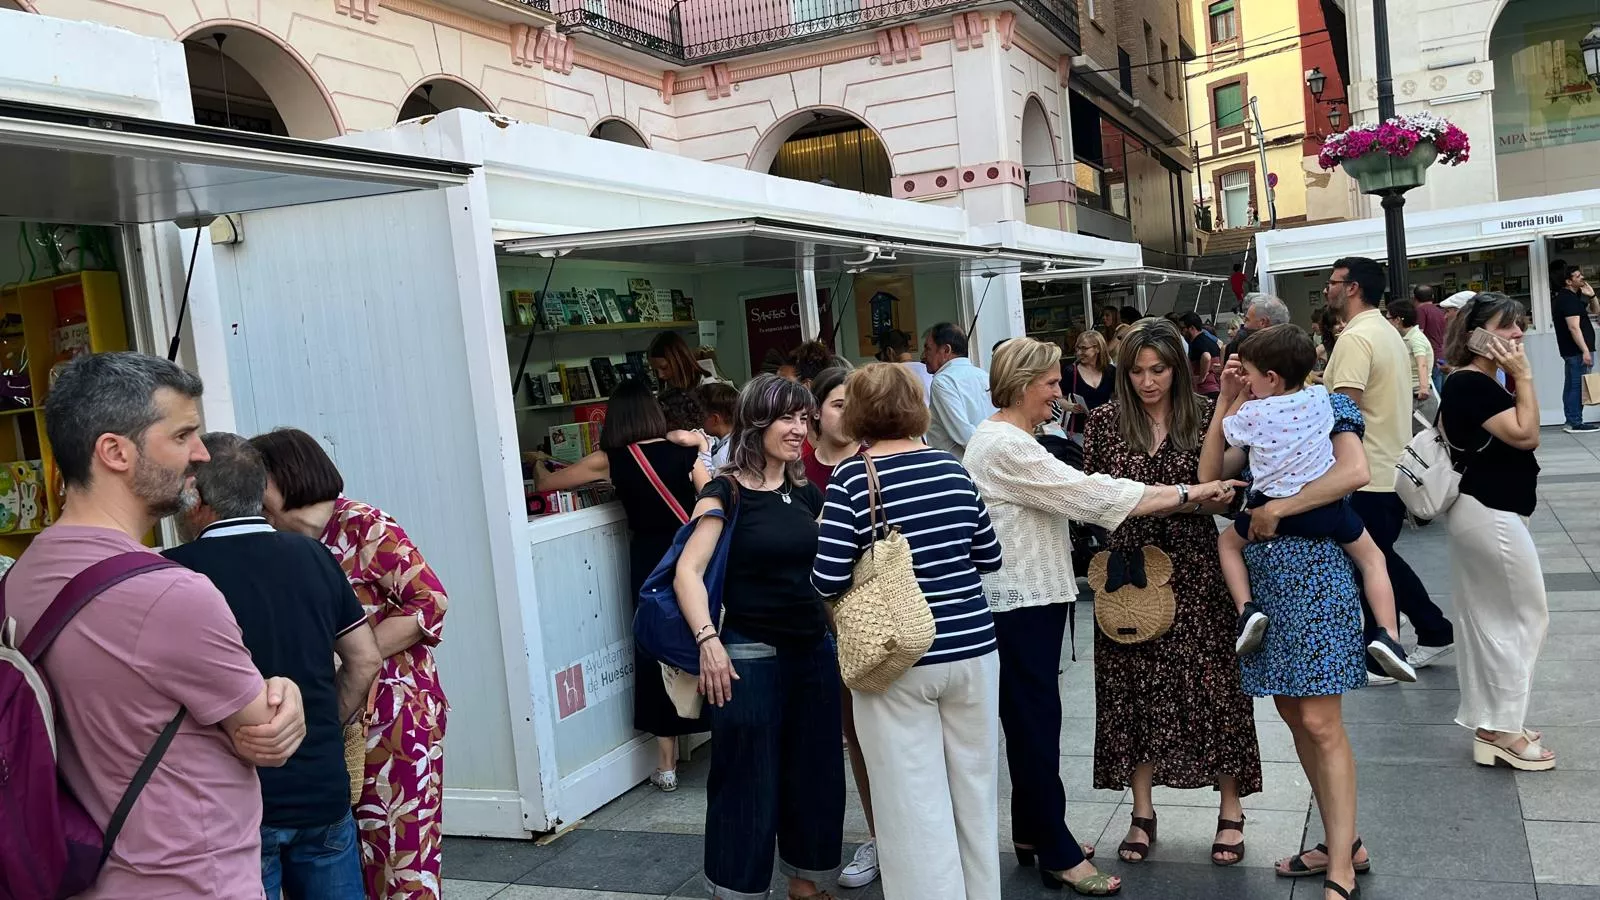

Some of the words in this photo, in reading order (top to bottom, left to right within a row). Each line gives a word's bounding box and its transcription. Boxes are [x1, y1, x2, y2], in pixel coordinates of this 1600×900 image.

[1498, 133, 1528, 145] MPA
[1501, 217, 1535, 230] Librería
[1537, 216, 1544, 225] El
[1546, 214, 1563, 225] Iglú
[586, 645, 633, 675] Ayuntamie
[587, 678, 599, 693] de
[601, 663, 634, 687] Huesca
